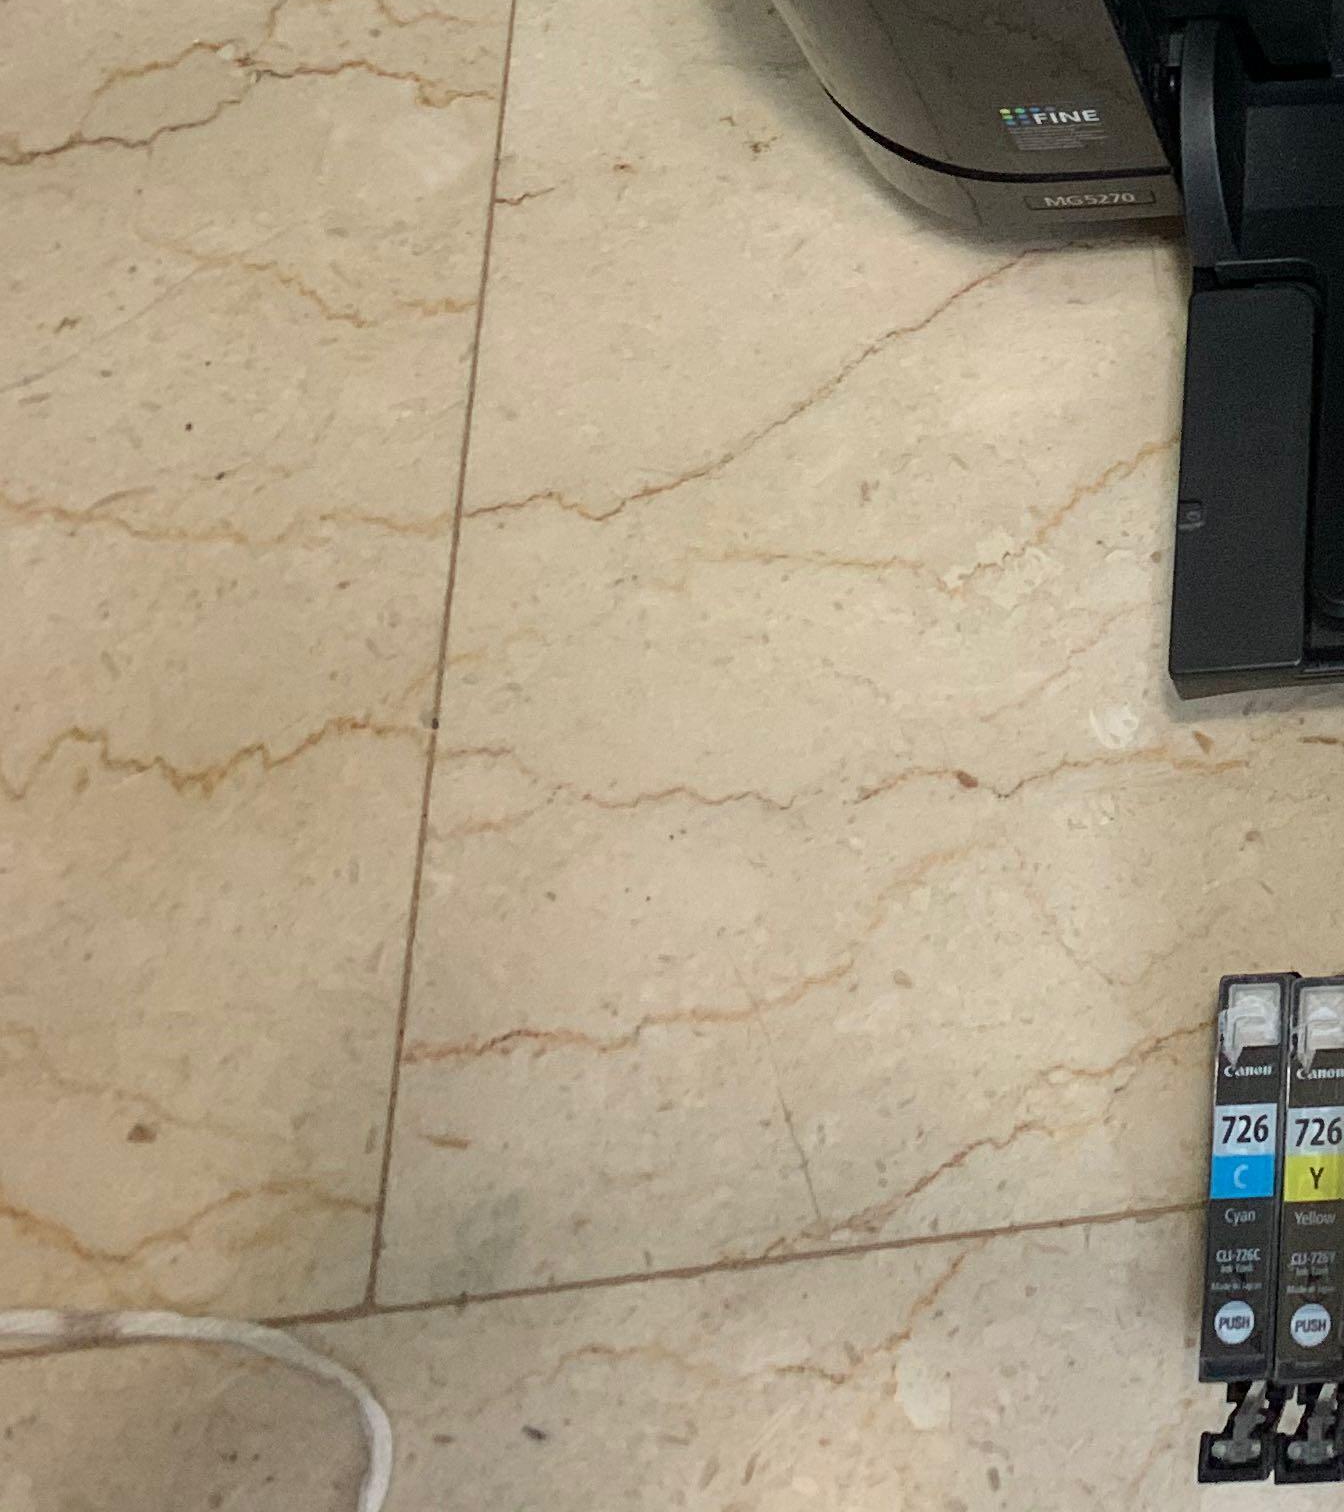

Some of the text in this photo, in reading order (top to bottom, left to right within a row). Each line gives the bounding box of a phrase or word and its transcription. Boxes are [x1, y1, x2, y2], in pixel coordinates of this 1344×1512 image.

[1033, 109, 1100, 125] FINE
[1044, 193, 1136, 207] MG5270
[1224, 1064, 1272, 1078] Canon
[1221, 1114, 1269, 1144] 726
[1294, 1117, 1343, 1147] 726
[1233, 1164, 1249, 1188] C
[1309, 1166, 1325, 1190] Y
[1224, 1208, 1256, 1227] Cyan
[1294, 1210, 1336, 1226] Yellow
[1218, 1316, 1251, 1330] PUSH
[1294, 1317, 1327, 1333] PUSH
